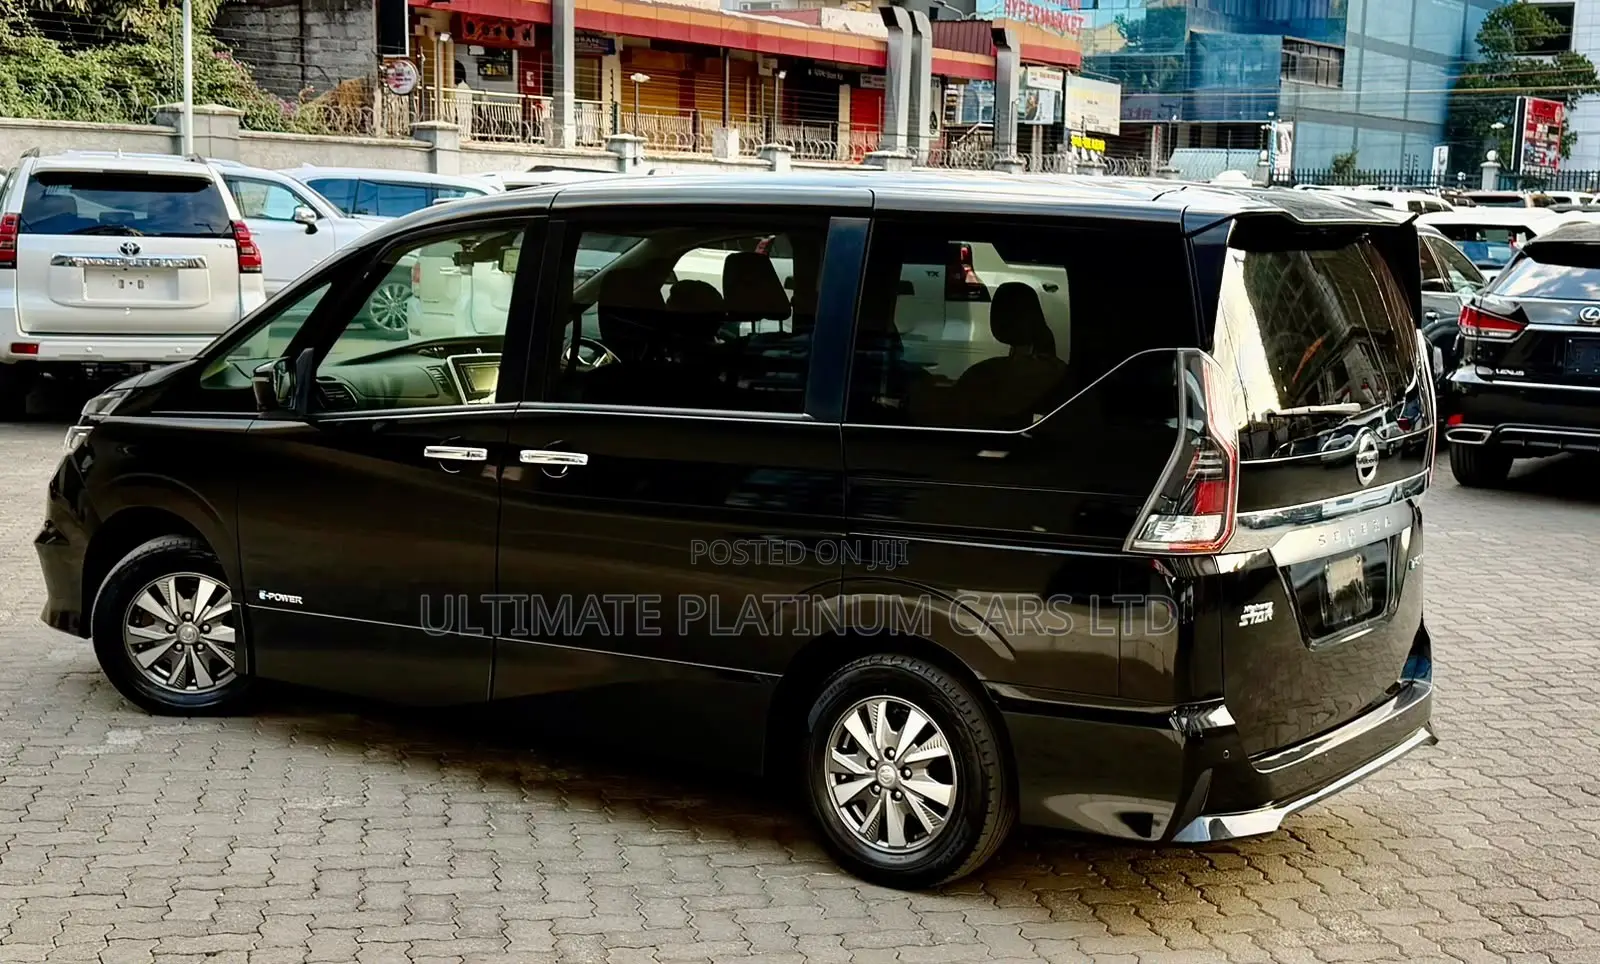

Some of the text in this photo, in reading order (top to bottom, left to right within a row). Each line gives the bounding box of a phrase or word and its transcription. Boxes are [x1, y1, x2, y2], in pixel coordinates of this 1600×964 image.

[1004, 0, 1085, 36] HYPERMARKET
[1496, 368, 1525, 377] LEXUS
[1238, 610, 1273, 627] STAR
